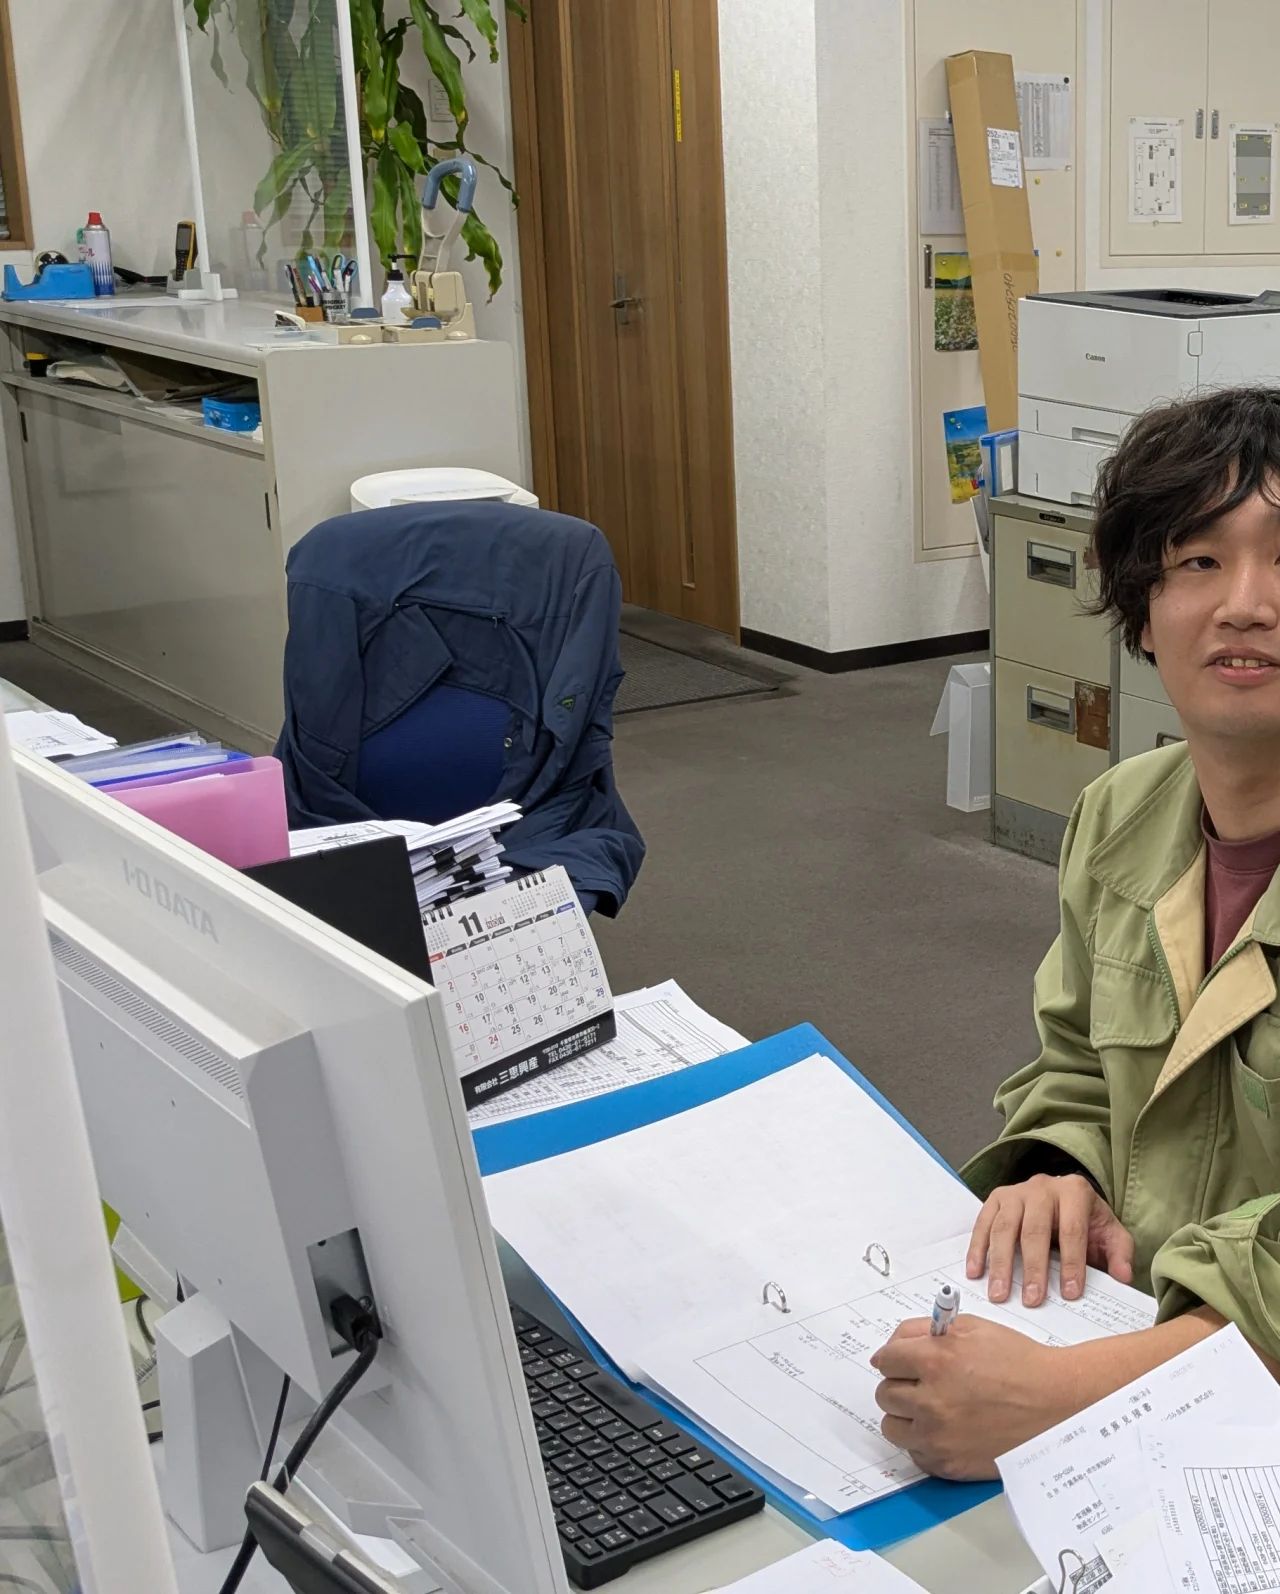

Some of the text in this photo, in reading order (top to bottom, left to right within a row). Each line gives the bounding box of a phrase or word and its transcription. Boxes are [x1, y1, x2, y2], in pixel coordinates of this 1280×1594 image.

[1085, 352, 1106, 363] Canon
[154, 877, 219, 944] DATA
[458, 912, 506, 937] 11 NOV
[572, 910, 577, 918] 1
[448, 929, 586, 990] 2 3 4 5 6 7 8
[456, 948, 593, 1011] 9 10 11 12 13 14 15
[459, 968, 599, 1034] 16 17 18 19 20 21 22
[489, 1034, 499, 1045] 24
[511, 1025, 521, 1035] 25
[534, 1015, 544, 1025] 26
[555, 1005, 564, 1015] 27
[577, 997, 585, 1006] 28
[596, 988, 605, 997] 29
[474, 1056, 539, 1094] 有限会社 三恵興産
[1098, 1401, 1154, 1439] 概算見積書
[1190, 1494, 1210, 1535] 1000030747
